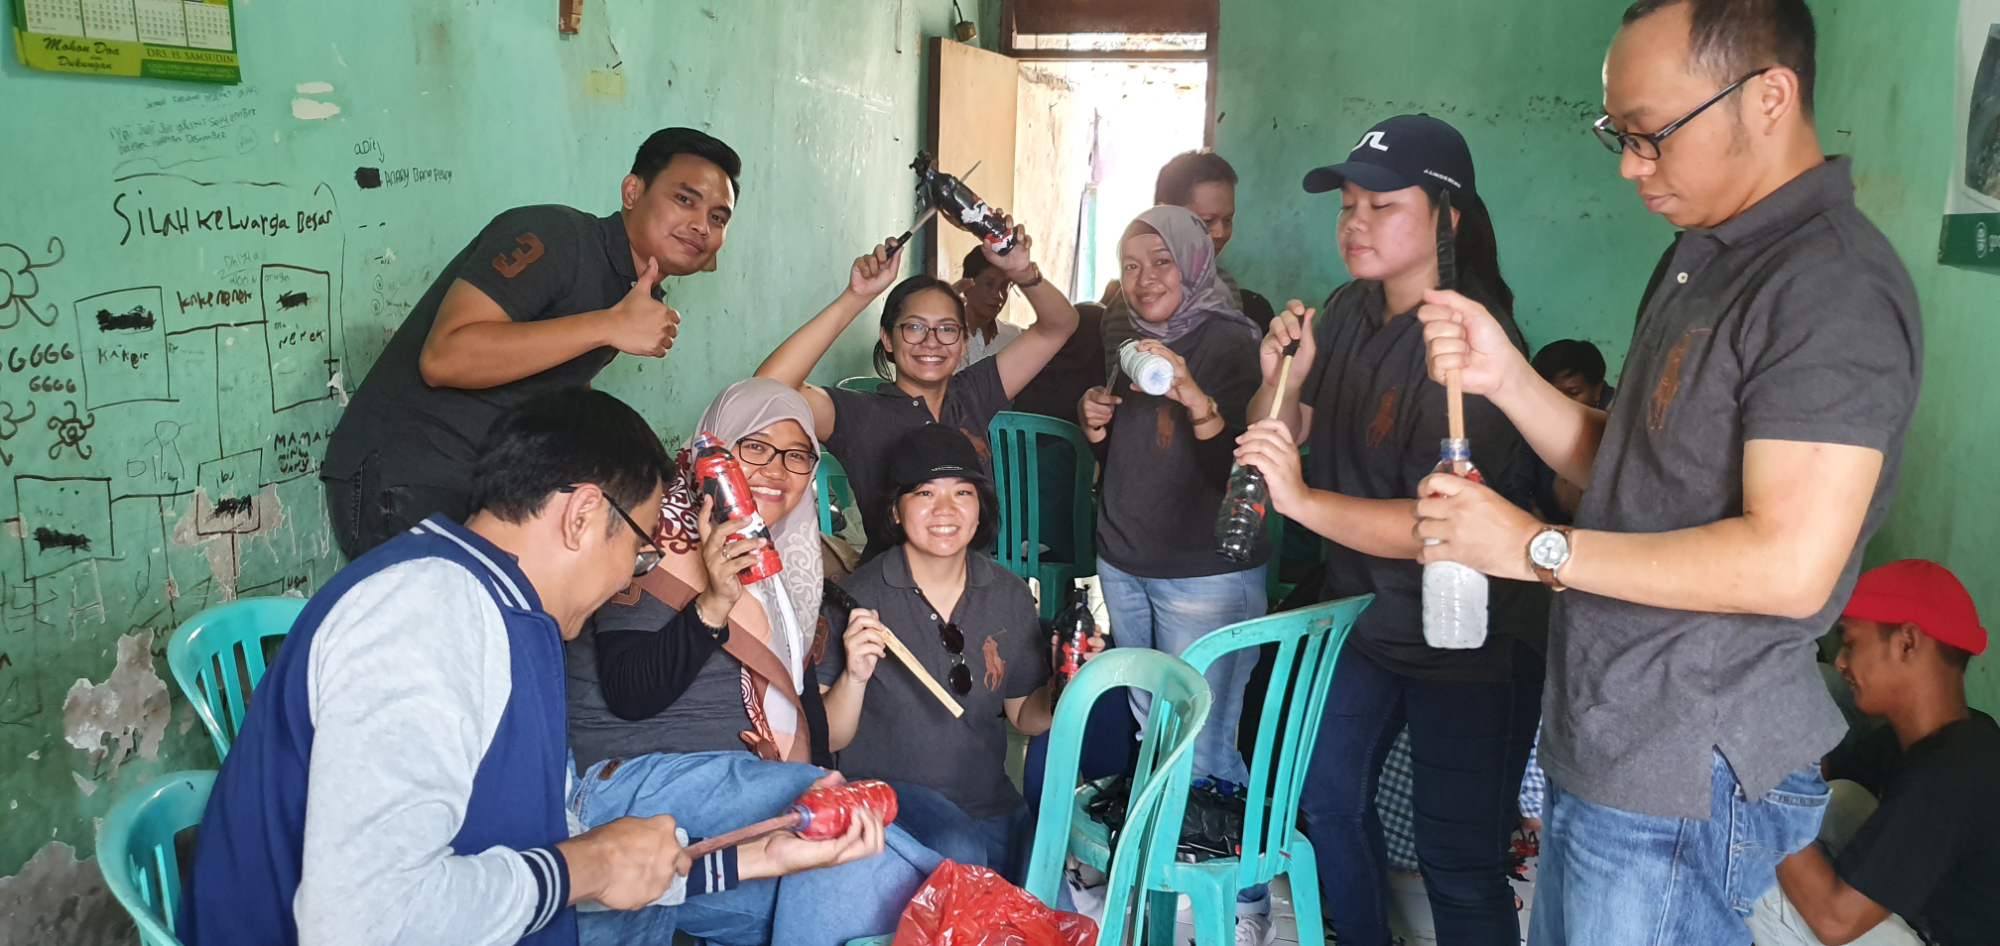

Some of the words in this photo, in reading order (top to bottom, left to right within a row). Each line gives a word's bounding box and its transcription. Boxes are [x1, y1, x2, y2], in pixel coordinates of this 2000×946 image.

[43, 37, 90, 54] Mohon
[94, 41, 120, 56] Doa
[57, 55, 113, 71] Dukungan
[184, 51, 234, 64] SAMSUDIN
[492, 232, 545, 278] 3
